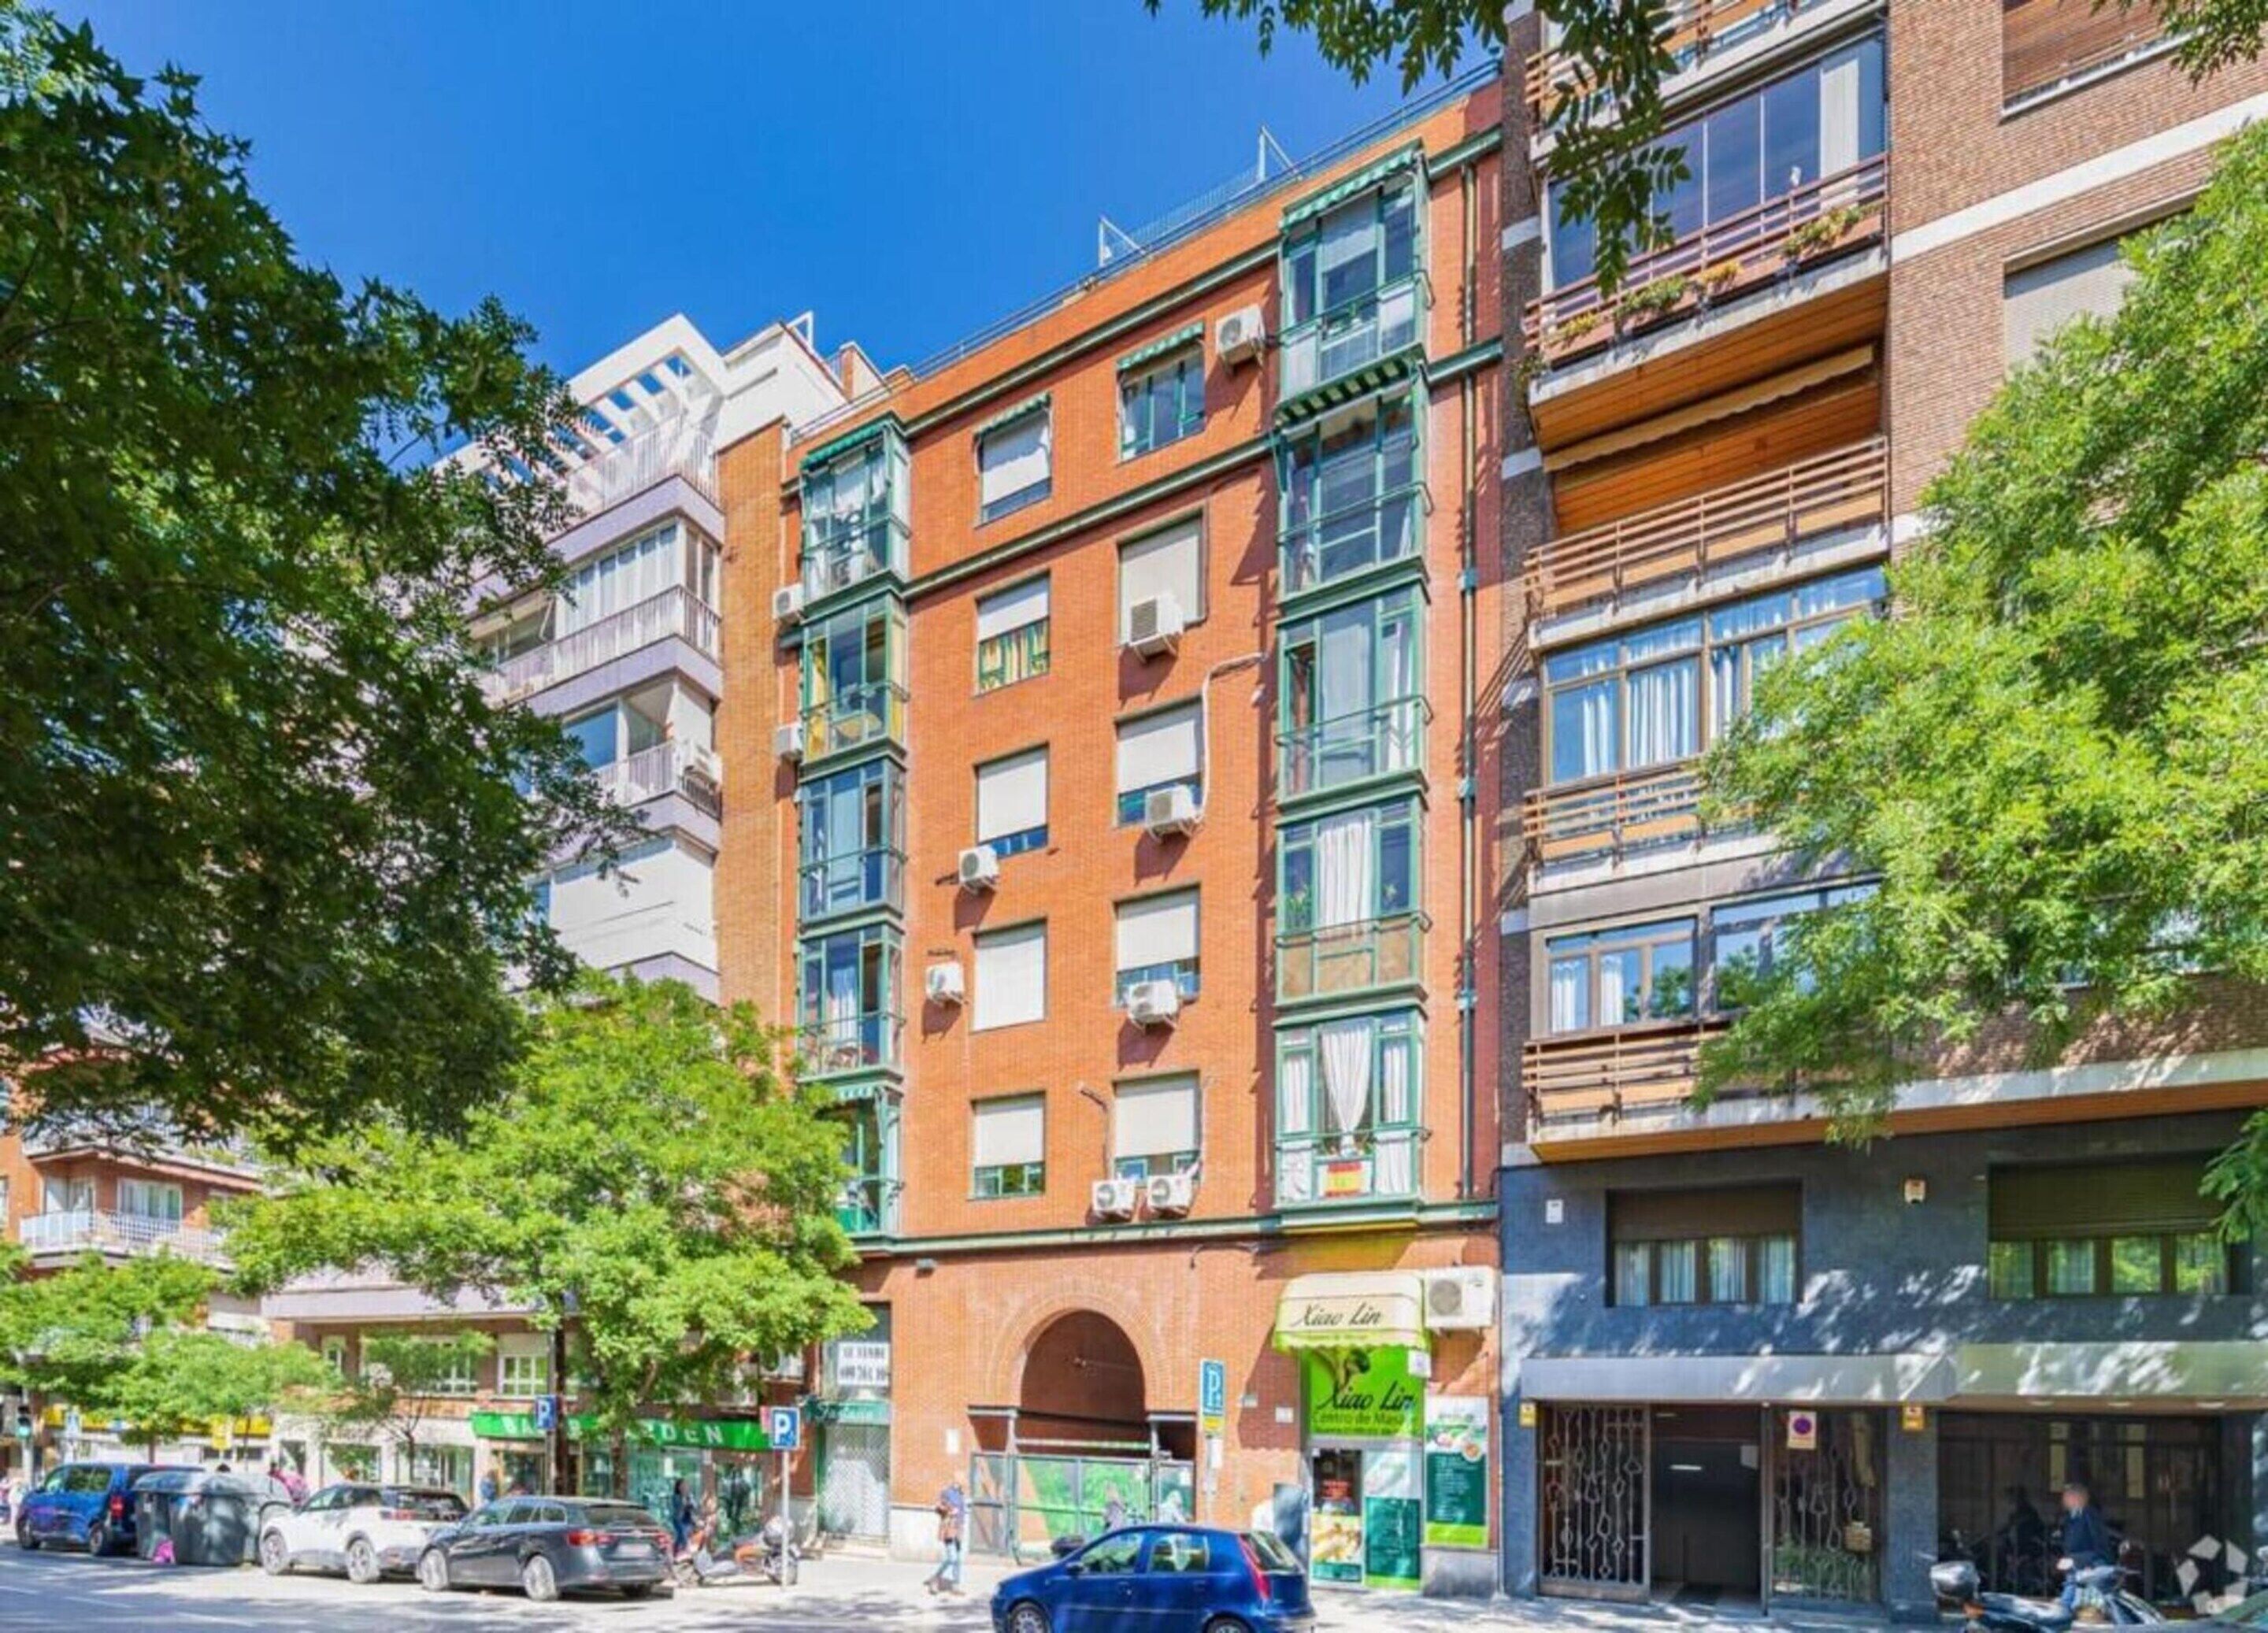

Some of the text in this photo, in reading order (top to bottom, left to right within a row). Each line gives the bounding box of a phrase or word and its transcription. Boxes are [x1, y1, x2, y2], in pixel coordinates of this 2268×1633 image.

[1291, 1302, 1382, 1327] Xiao Lin
[1317, 1379, 1417, 1411] Xiao Lin
[537, 1399, 550, 1428] P
[774, 1413, 791, 1444] P
